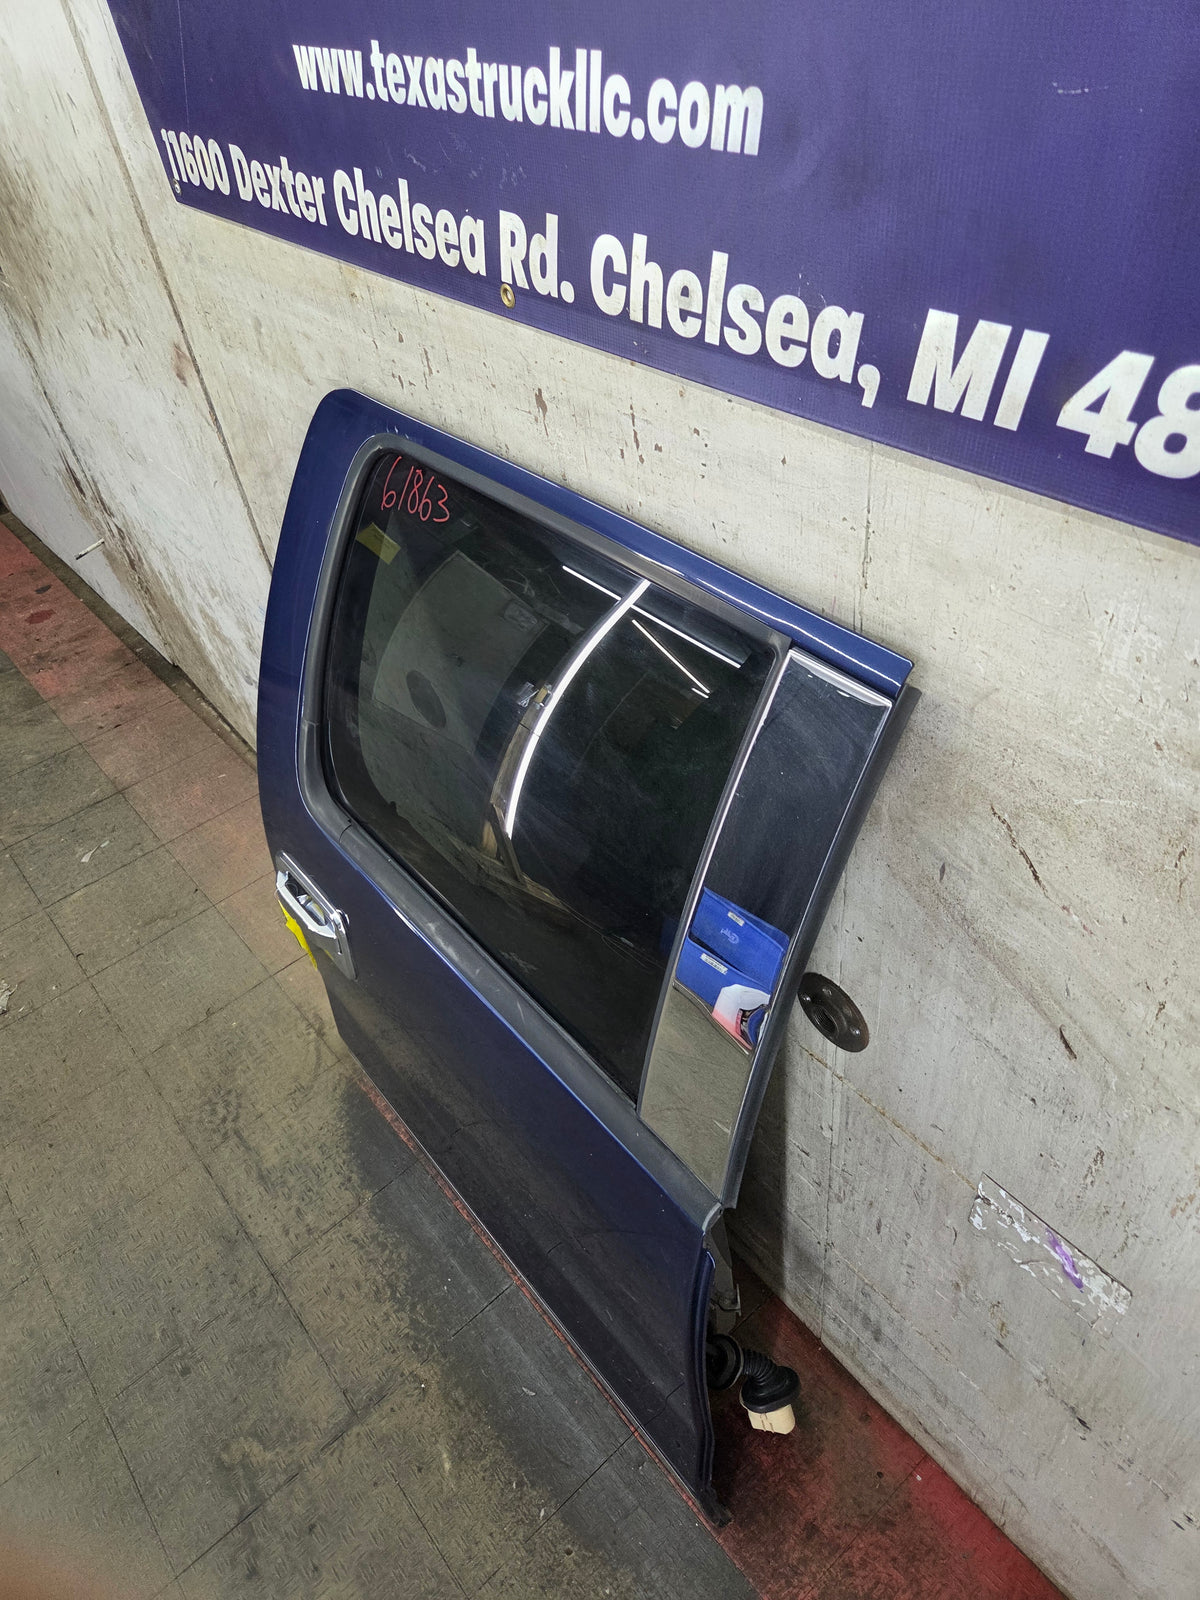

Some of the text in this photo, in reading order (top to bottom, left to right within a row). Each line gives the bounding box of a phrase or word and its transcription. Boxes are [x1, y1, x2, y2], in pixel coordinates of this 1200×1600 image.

[292, 39, 764, 157] www.texastruckllc.com
[161, 128, 231, 196] 11600
[228, 143, 328, 227] Dexter
[332, 166, 487, 277] Chelsea
[499, 209, 575, 304] Rd.
[590, 232, 881, 409] Chelsea,
[906, 307, 1051, 432] MI
[381, 456, 450, 523] 61863
